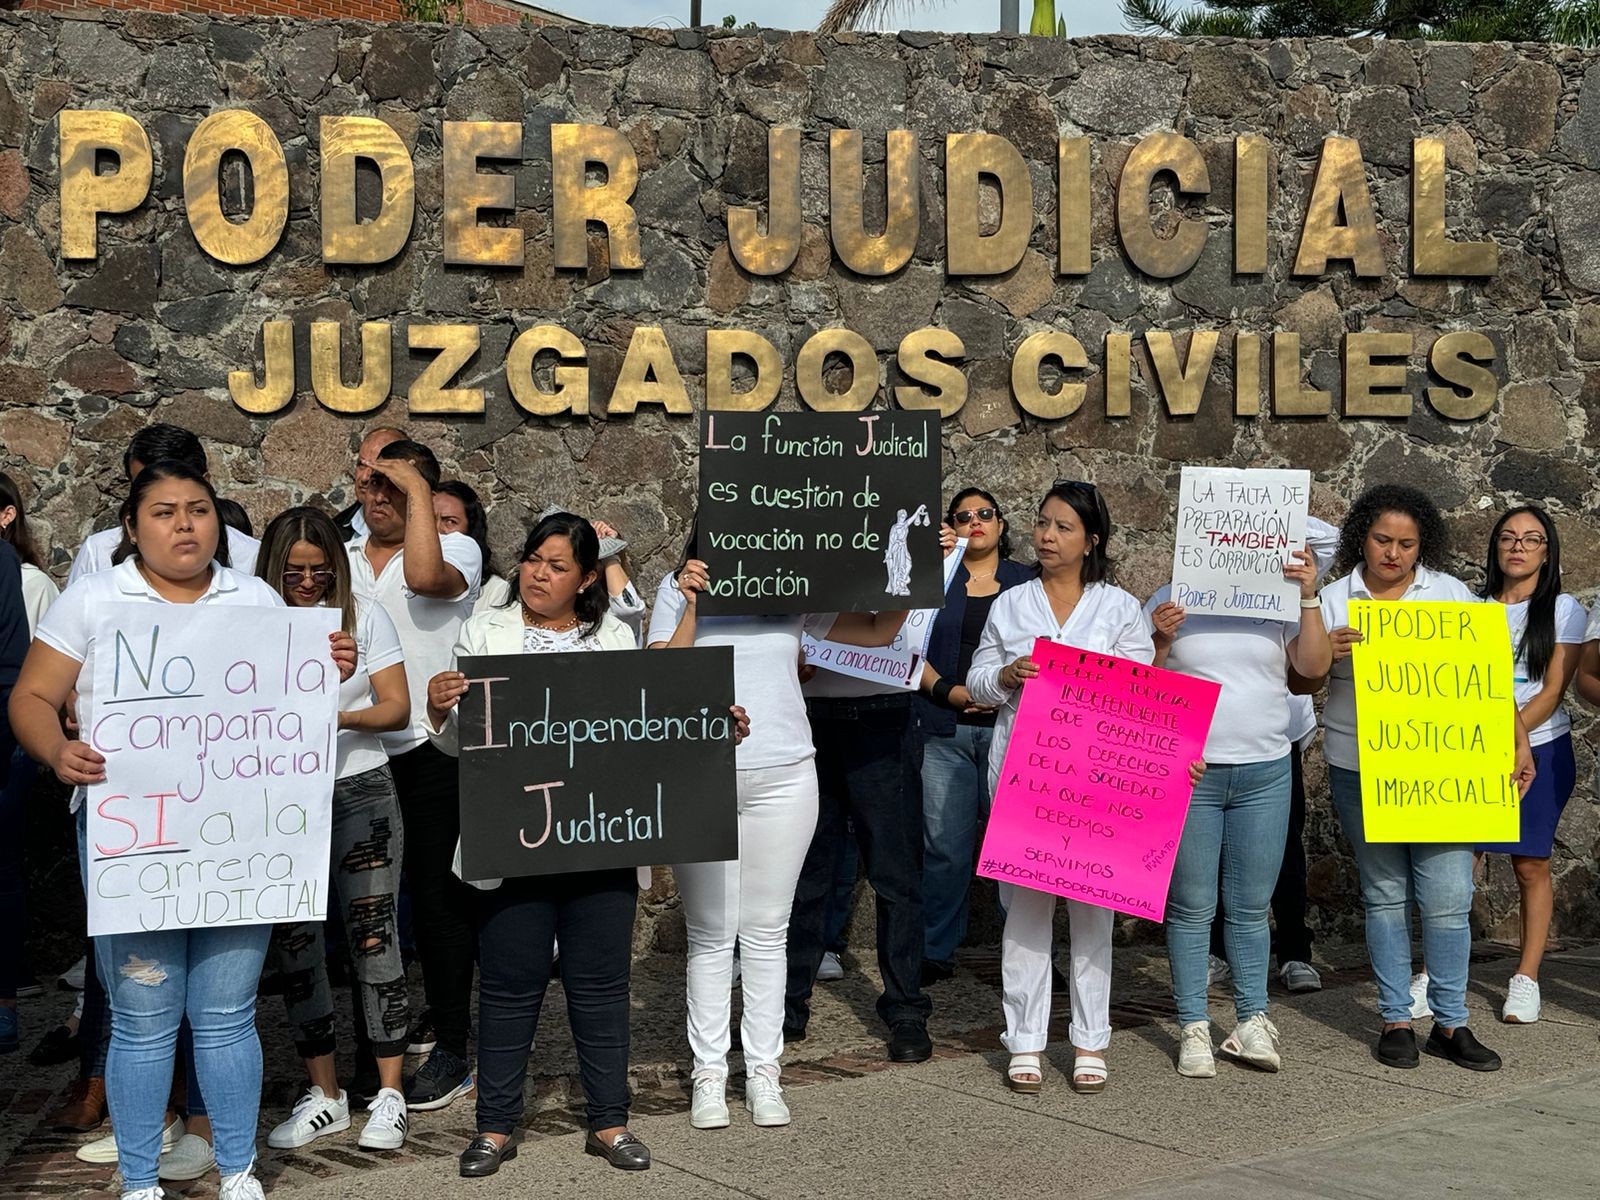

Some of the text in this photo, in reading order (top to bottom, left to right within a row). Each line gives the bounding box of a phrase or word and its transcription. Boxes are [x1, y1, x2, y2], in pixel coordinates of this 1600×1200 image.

[59, 110, 1500, 279] PODER JUDICIAL
[228, 320, 1500, 420] JUZGADOS CIVILES
[705, 414, 928, 458] La función Judicial
[708, 475, 880, 509] es cuestión de
[1193, 480, 1304, 506] LA FALTA DE
[708, 513, 880, 551] vocación no de
[1183, 506, 1291, 538] PREPARACIÓN
[704, 560, 809, 598] votación
[1179, 545, 1290, 575] ES CORRUPCIÓN
[1177, 583, 1217, 611] PODER
[114, 622, 326, 697] No a la
[819, 648, 832, 662] a
[835, 649, 920, 686] conocernos!
[1131, 665, 1159, 681] UN
[1048, 658, 1195, 711] PODER JUDICIAL
[1367, 660, 1507, 700] JUDICIAL
[462, 677, 730, 769] Independencia
[1061, 683, 1180, 730] INDEPENDIENTE
[1050, 707, 1180, 752] QUE GARANTICE
[1369, 719, 1485, 753] JUSTICIA
[1036, 731, 1170, 777] LOS DERECHOS
[1029, 752, 1166, 800] DE LA SOCIEDAD
[1376, 772, 1516, 808] IMPARCIAL!!
[519, 780, 663, 849] Judicial
[1008, 773, 1144, 820] A LA QUE NOS
[95, 788, 307, 856] SI a la
[1035, 806, 1115, 839] DEBEMOS
[1025, 847, 1114, 879] SERVIMOS
[1062, 835, 1071, 851] Y
[140, 879, 327, 932] JUDICIAL
